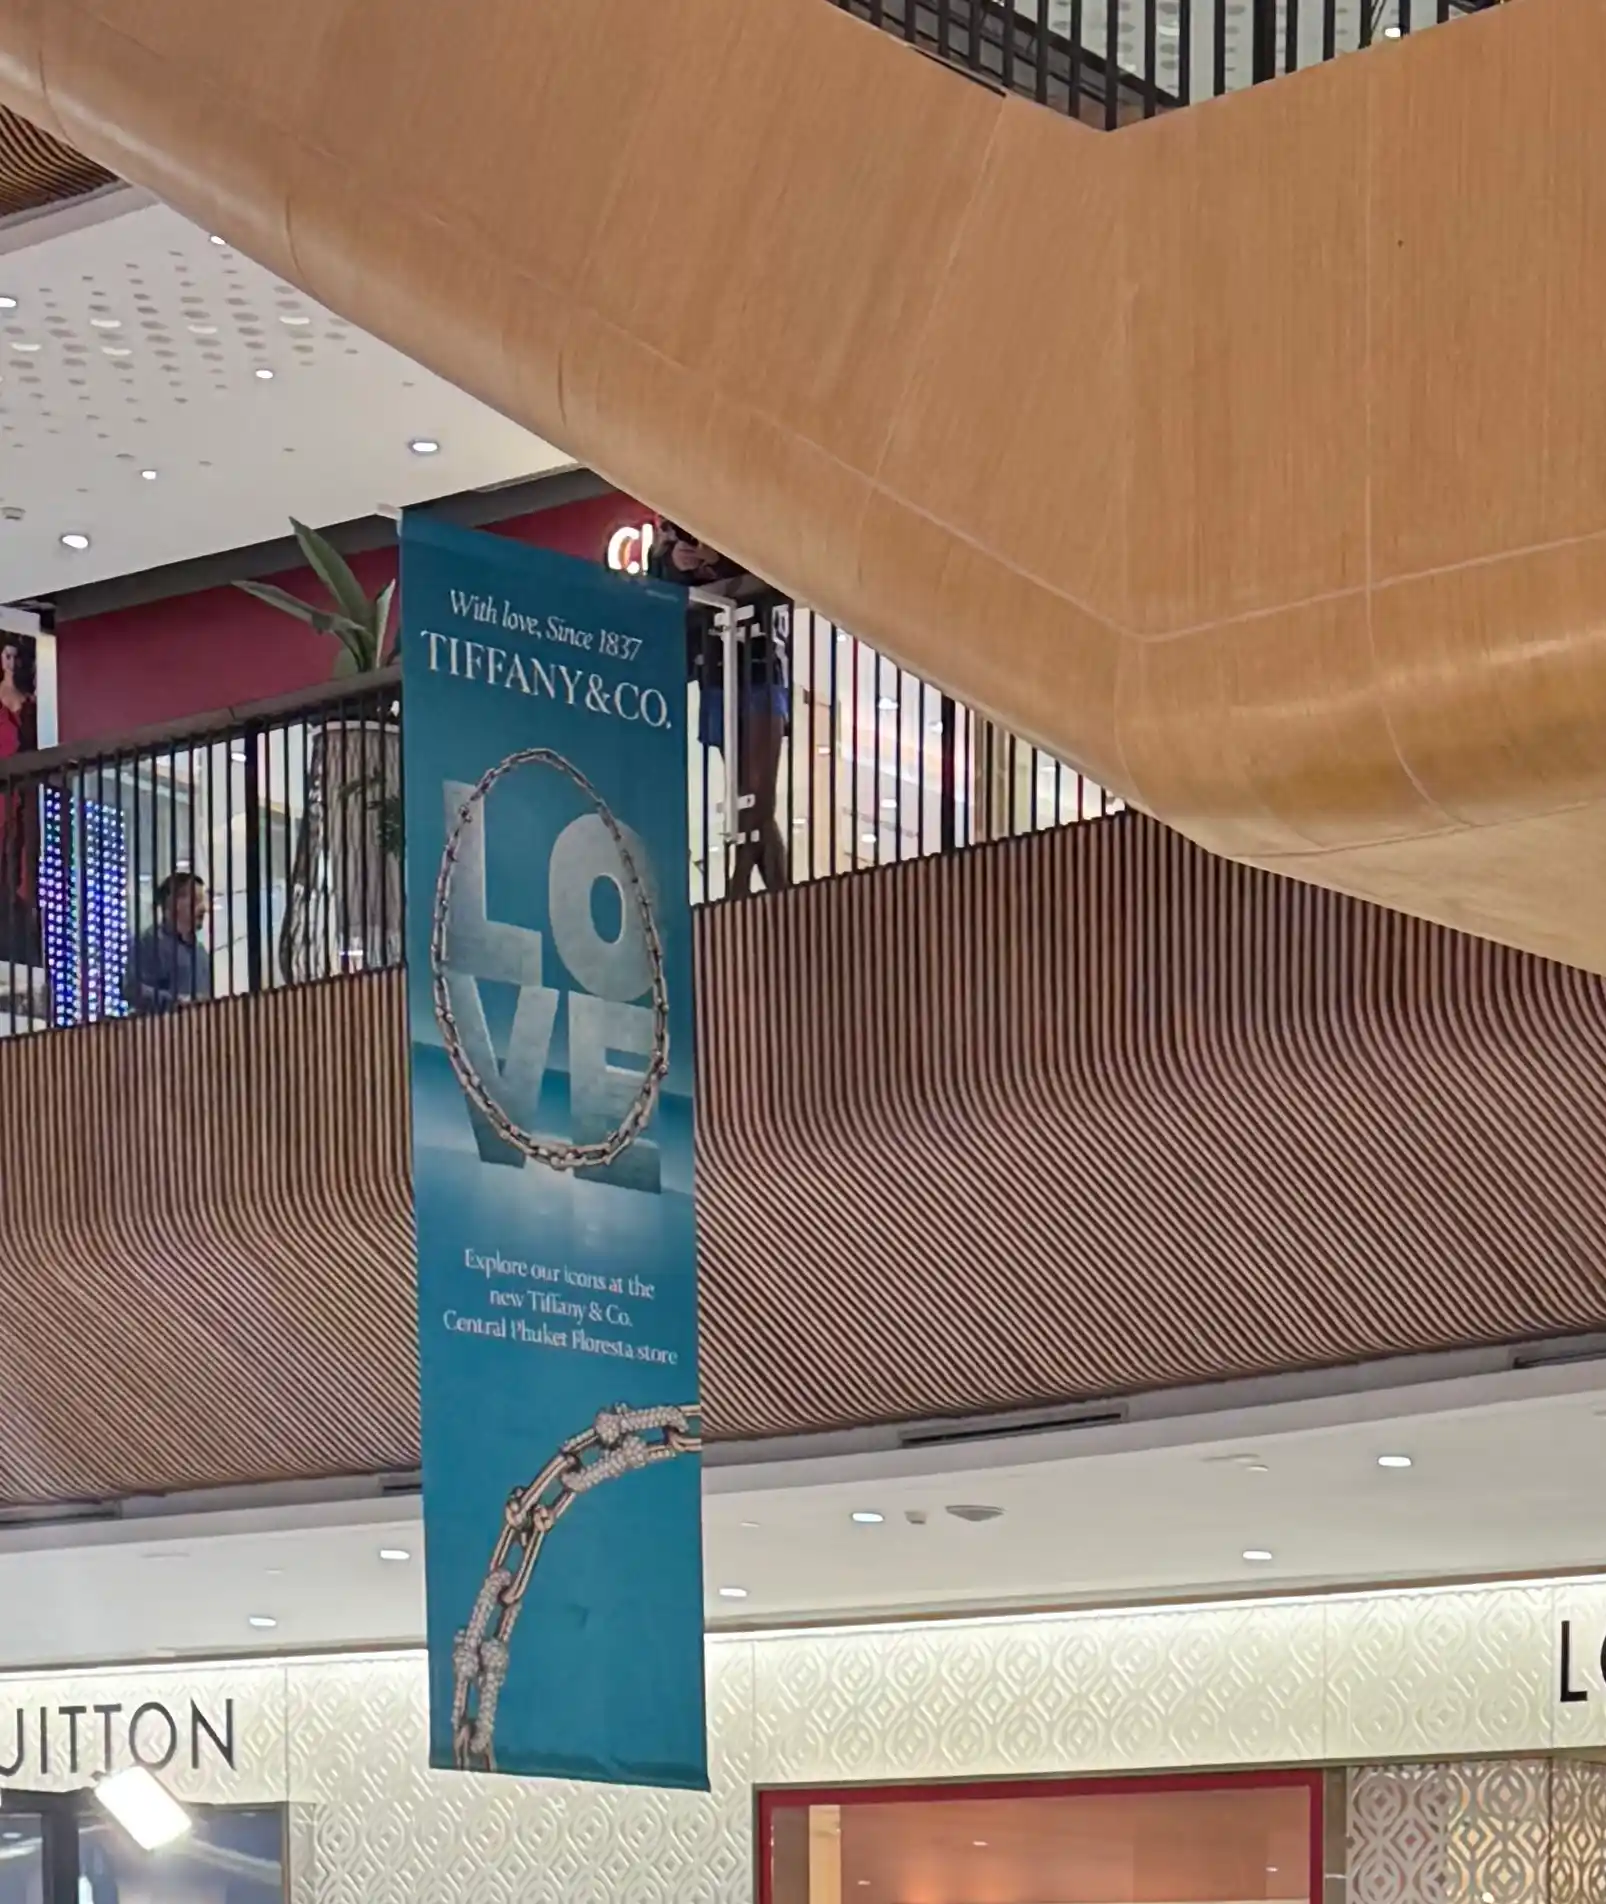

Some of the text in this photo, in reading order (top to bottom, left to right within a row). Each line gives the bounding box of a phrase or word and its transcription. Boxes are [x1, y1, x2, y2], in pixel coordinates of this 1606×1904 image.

[450, 589, 642, 661] With love, Since 1837
[465, 1248, 655, 1299] Explore our icons at the
[490, 1289, 633, 1327] new Tiffany & Co.
[443, 1309, 678, 1365] Central Phuket Floresta store
